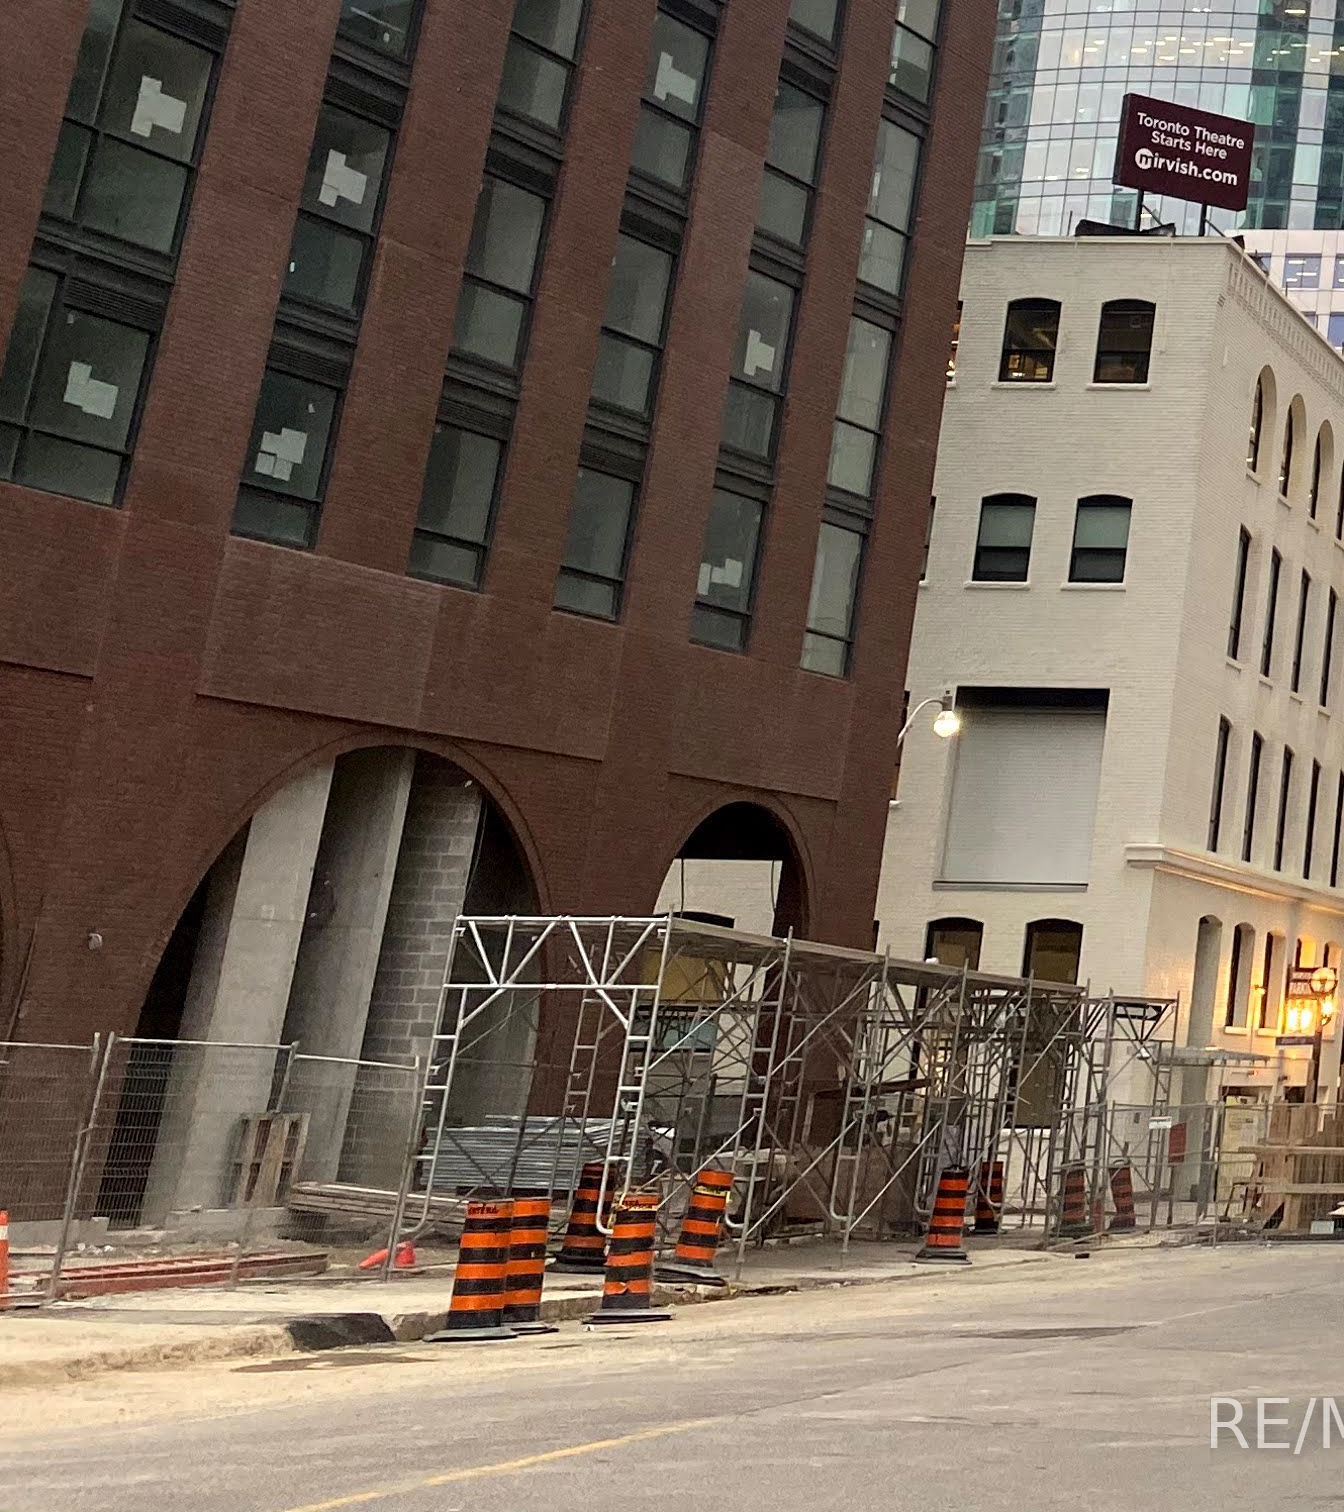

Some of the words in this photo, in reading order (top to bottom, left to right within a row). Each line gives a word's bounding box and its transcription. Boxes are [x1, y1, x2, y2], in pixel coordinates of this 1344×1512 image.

[1137, 112, 1190, 136] Toronto
[1194, 126, 1245, 149] Theatre
[1151, 130, 1191, 151] Starts
[1195, 141, 1227, 159] Here
